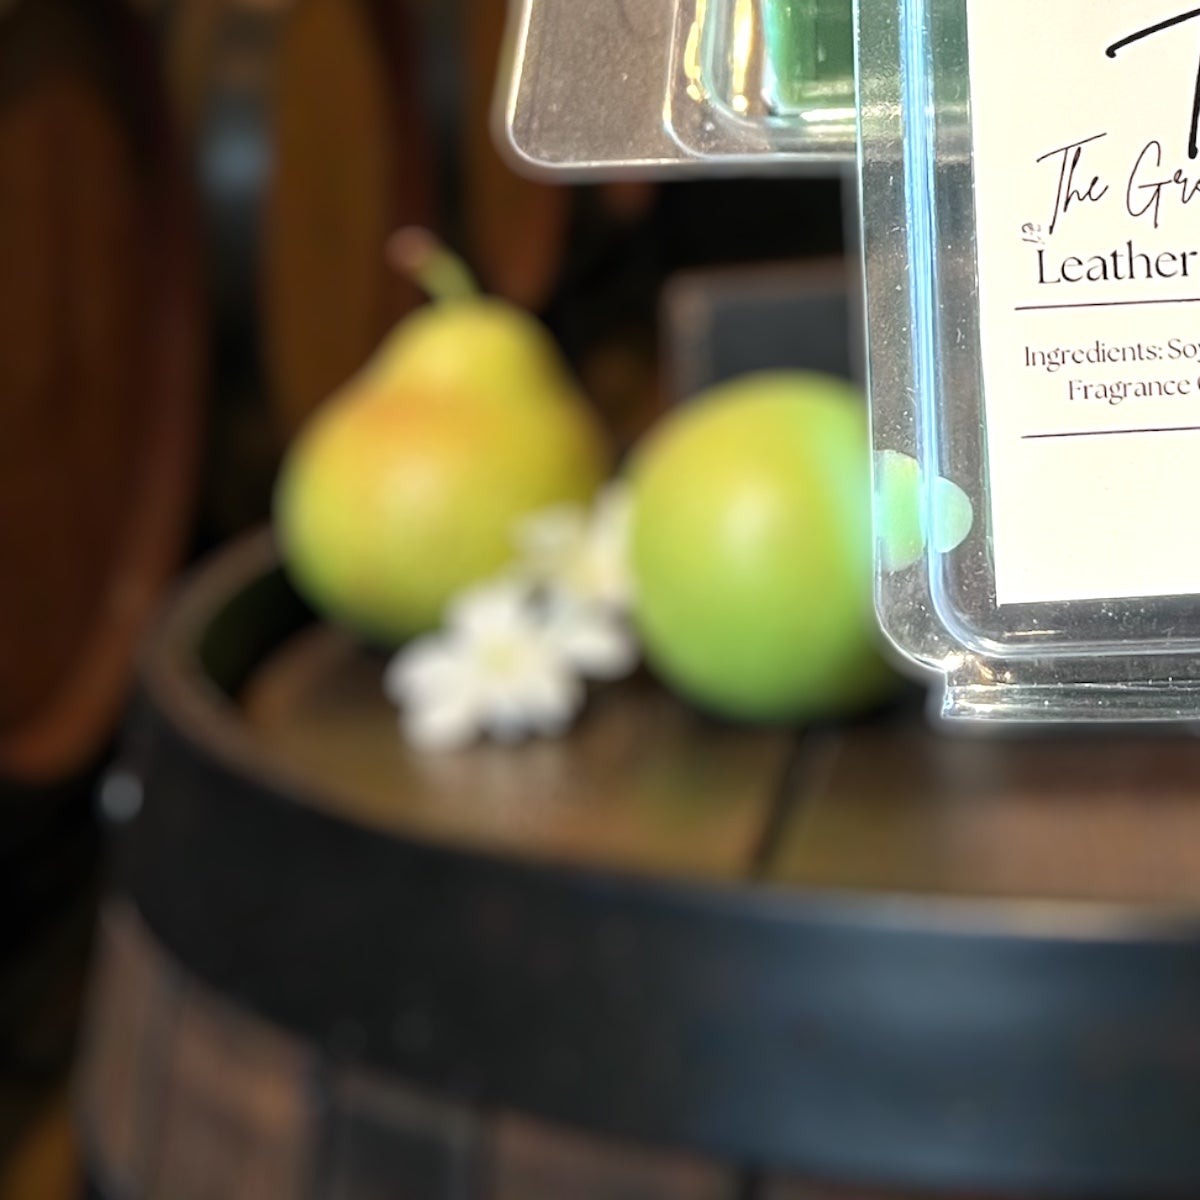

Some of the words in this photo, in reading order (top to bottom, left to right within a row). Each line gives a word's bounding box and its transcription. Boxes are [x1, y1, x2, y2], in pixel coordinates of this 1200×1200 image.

[1036, 132, 1109, 234] The
[1025, 340, 1163, 372] Ingredients:
[1068, 378, 1190, 405] Fragrance
